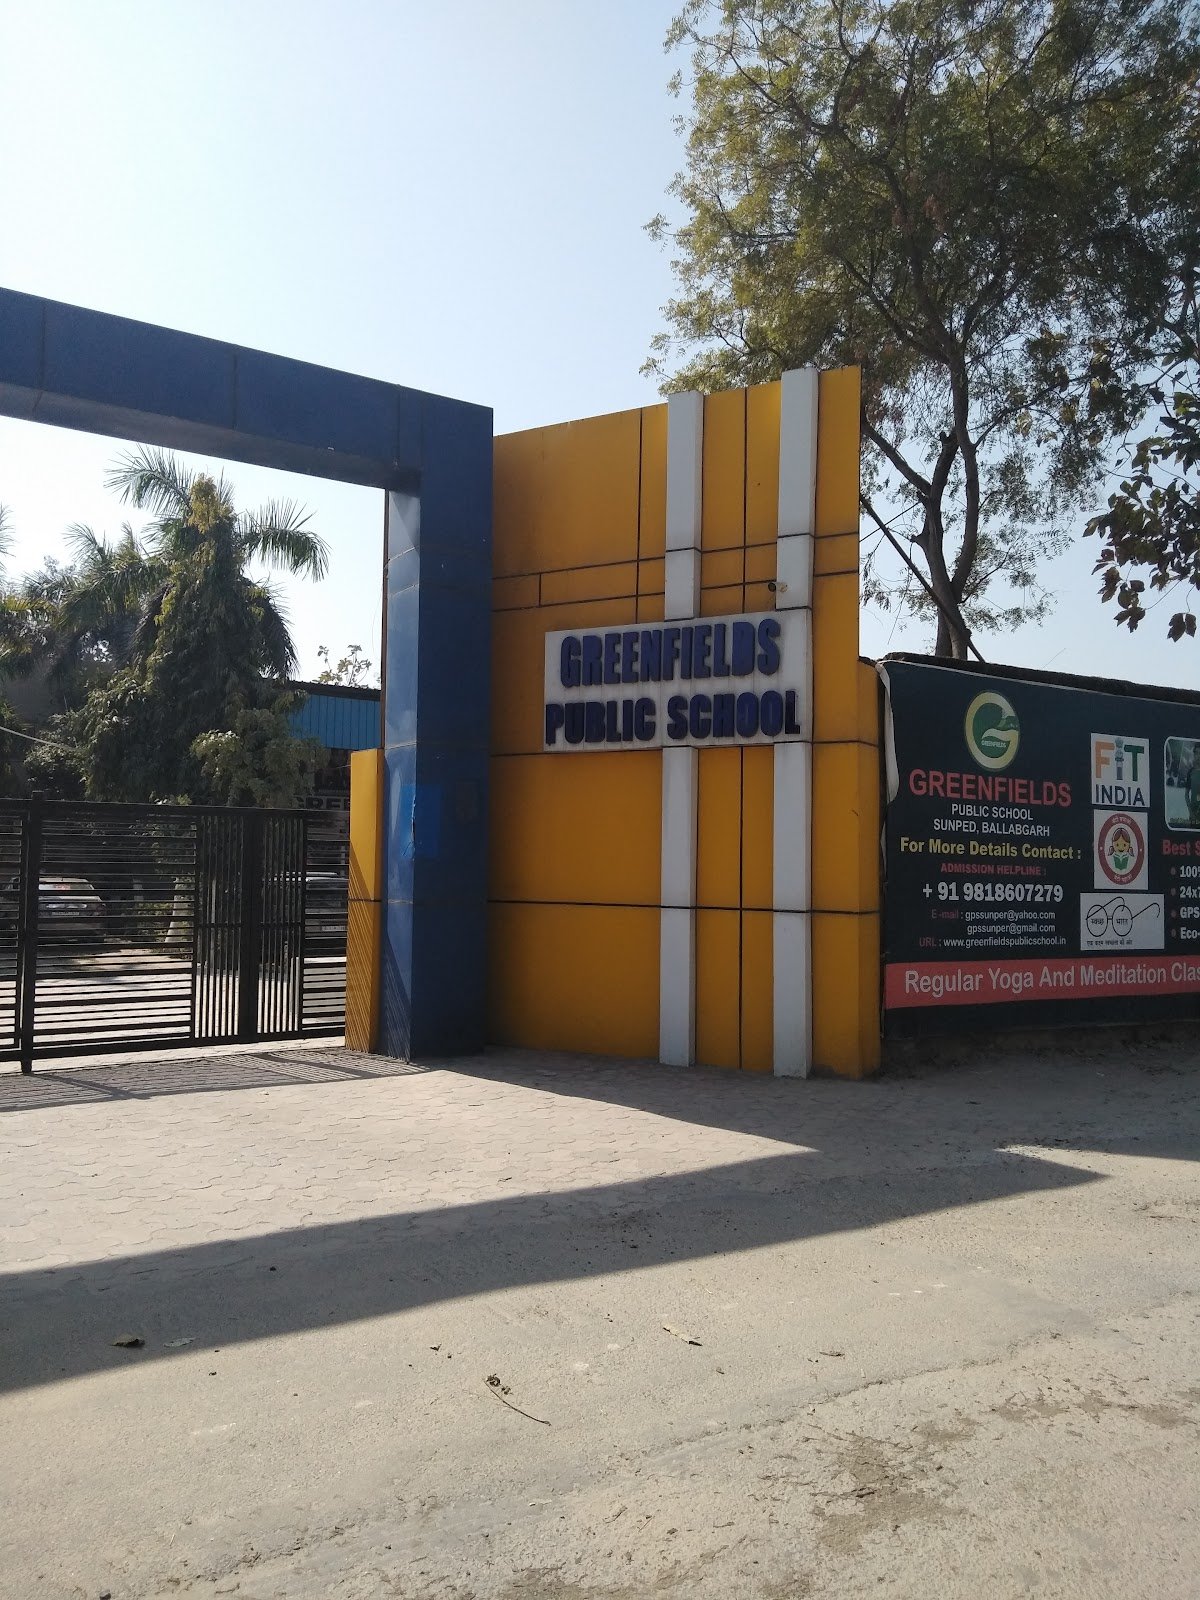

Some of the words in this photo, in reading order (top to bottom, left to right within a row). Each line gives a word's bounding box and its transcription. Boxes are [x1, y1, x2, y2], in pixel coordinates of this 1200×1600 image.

[560, 618, 781, 688] GREENFIELDS
[545, 697, 656, 746] PUBLIC
[667, 690, 800, 740] SCHOOL
[909, 768, 1072, 807] GREENFIELDS
[1096, 784, 1145, 806] INDIA
[951, 803, 989, 818] PUBLIC
[991, 806, 1034, 821] SCHOOL
[933, 818, 980, 834] SUNPED,
[982, 821, 1050, 837] BALLABGARH
[900, 836, 925, 853] For
[929, 838, 965, 855] More
[969, 840, 1018, 857] Details
[1021, 843, 1074, 860] Contact
[1162, 839, 1191, 856] Best
[940, 862, 994, 874] ADMISSION
[997, 864, 1041, 876] HELPLINE
[937, 881, 960, 901] 91
[963, 882, 1064, 902] 9818607279
[965, 909, 1056, 921] gpssunper@yahoo.com
[967, 922, 1056, 935] gpssunper@gmail.com
[919, 937, 937, 947] URL
[943, 935, 1067, 949] www.greenfieldspublicschool.in
[905, 968, 984, 998] Regular
[988, 967, 1034, 994] Yoga
[1039, 965, 1075, 987] And
[1080, 962, 1167, 986] Meditation
